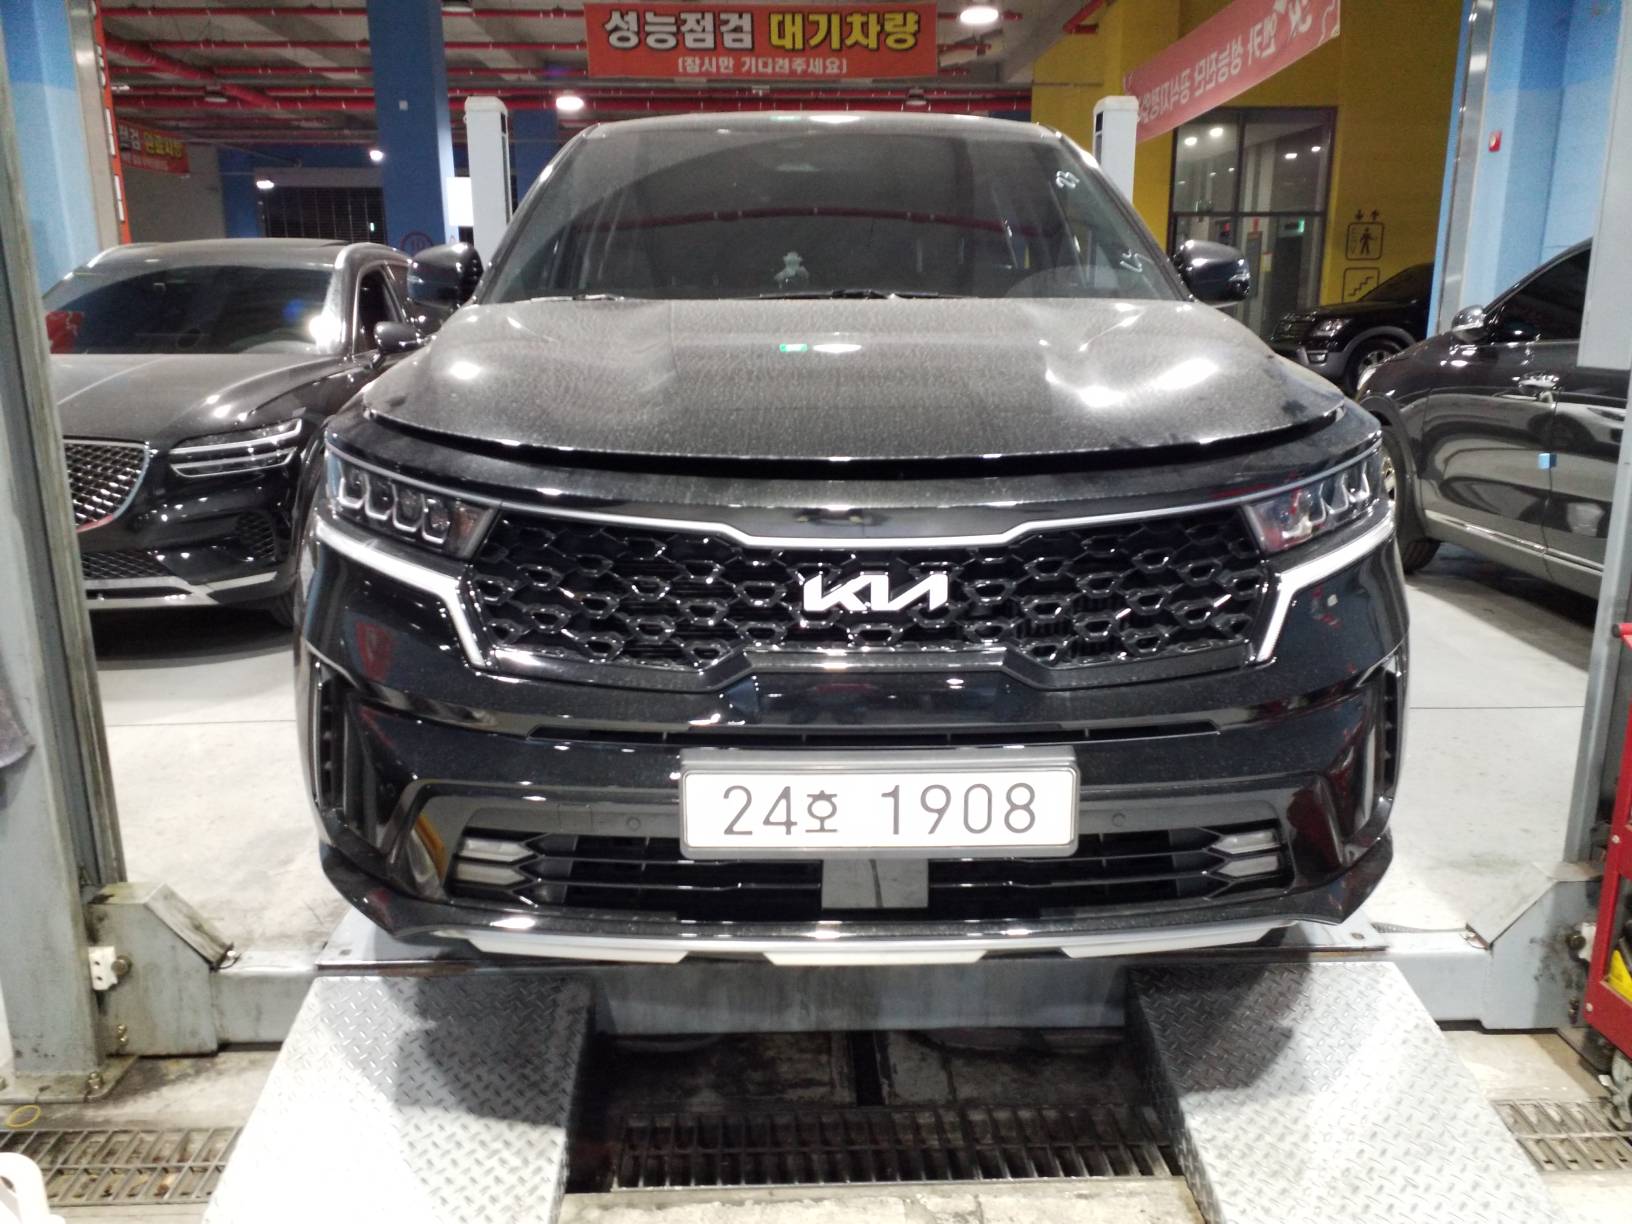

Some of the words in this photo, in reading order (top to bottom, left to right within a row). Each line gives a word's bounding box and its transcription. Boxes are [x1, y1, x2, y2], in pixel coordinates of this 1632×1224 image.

[604, 9, 754, 50] 성능점검
[769, 11, 920, 50] 대기차량
[804, 571, 949, 612] KIA
[723, 785, 839, 836] 24호
[881, 782, 1036, 835] 1908
